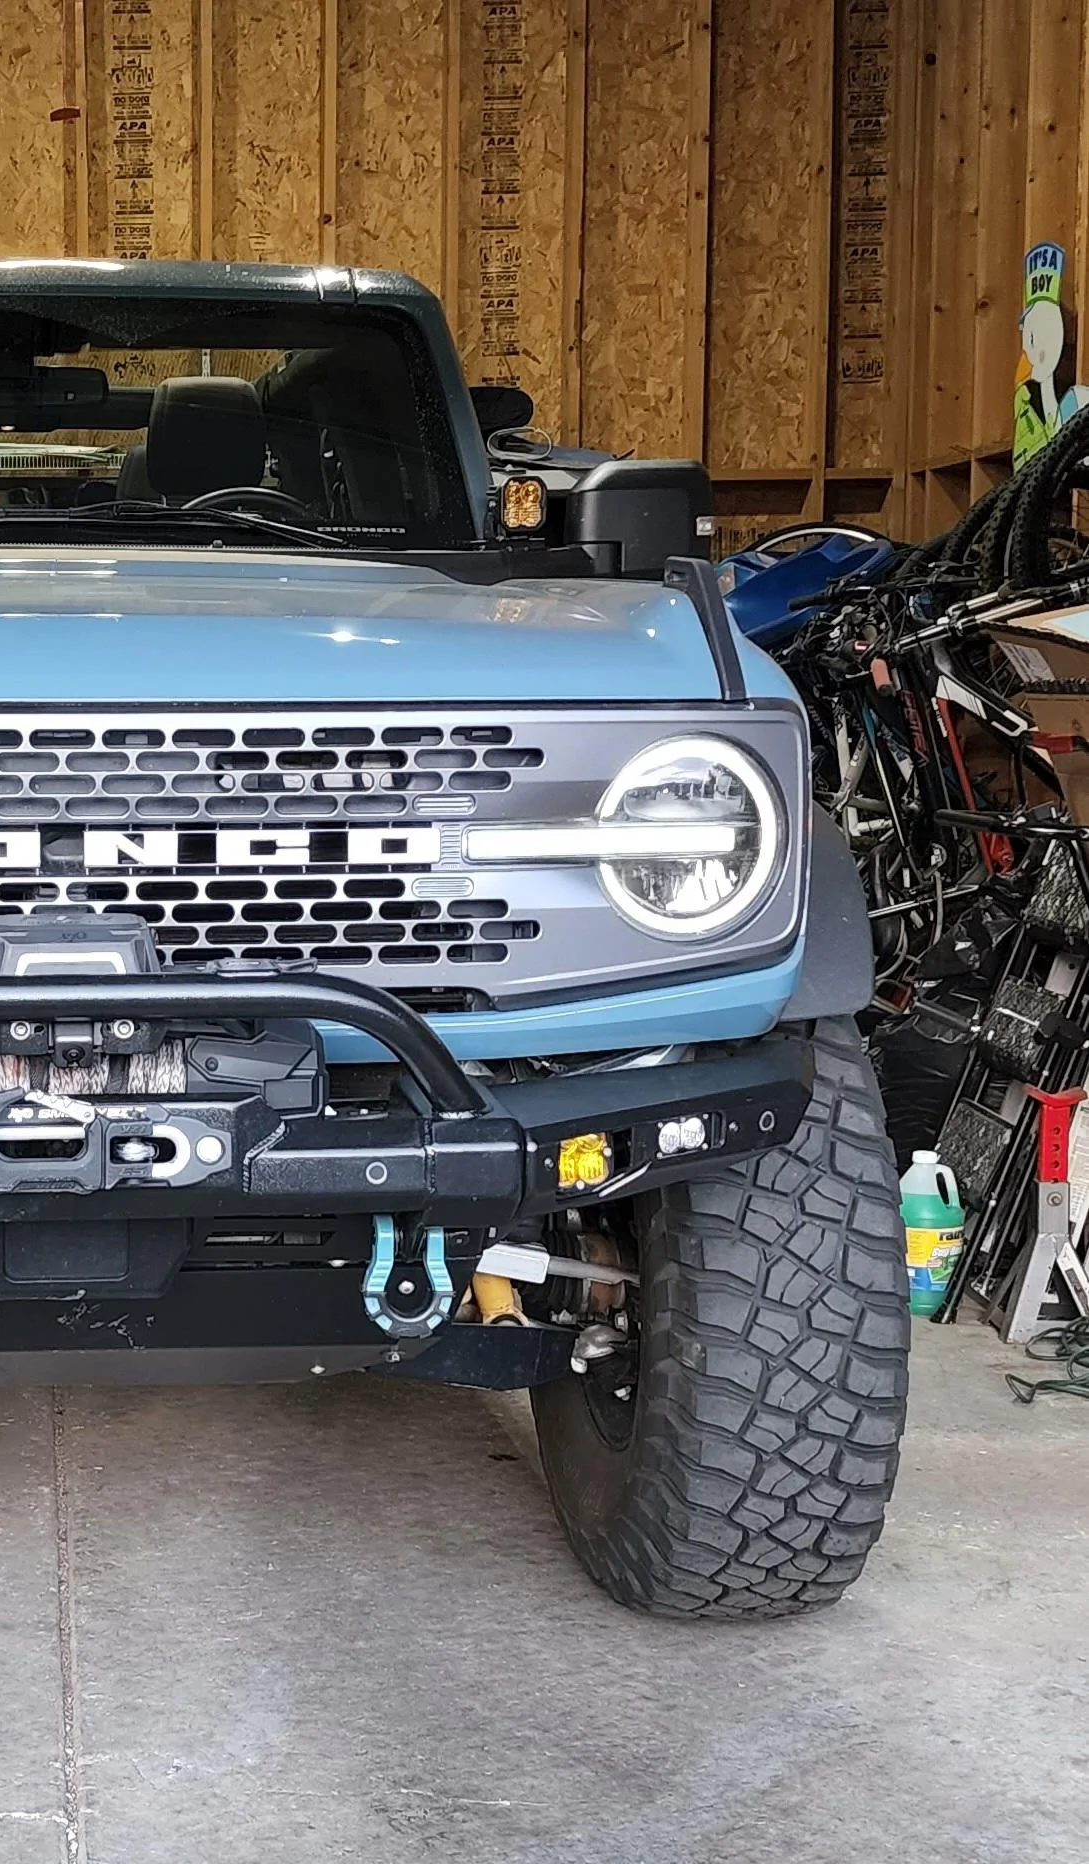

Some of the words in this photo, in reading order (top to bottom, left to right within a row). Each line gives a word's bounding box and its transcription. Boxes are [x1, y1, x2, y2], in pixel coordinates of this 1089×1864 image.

[489, 7, 516, 16] APA
[118, 121, 147, 131] APA
[486, 137, 515, 146] APA
[120, 251, 147, 260] APA
[850, 248, 879, 257] APA
[1029, 248, 1049, 275] IT'S
[1049, 250, 1058, 271] A
[1031, 273, 1054, 296] BOY
[486, 299, 514, 309] APA
[316, 526, 406, 534] BRONCO
